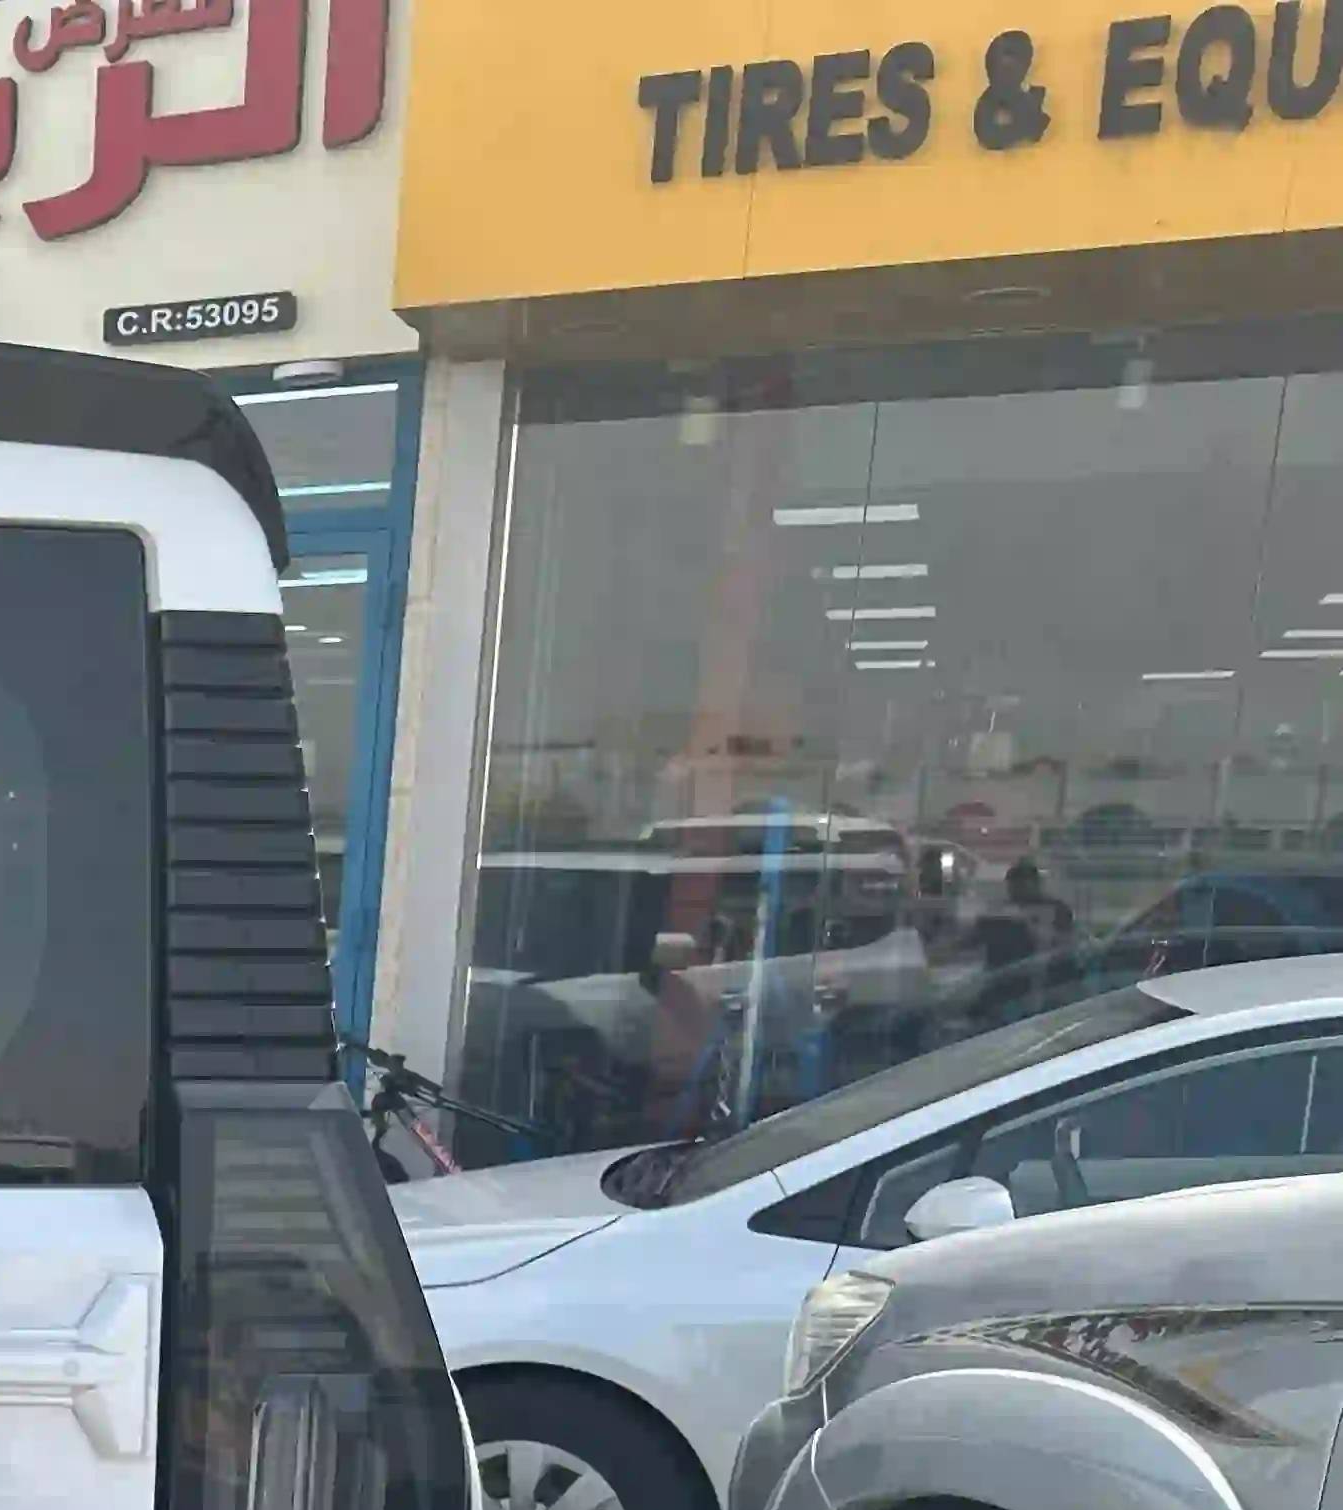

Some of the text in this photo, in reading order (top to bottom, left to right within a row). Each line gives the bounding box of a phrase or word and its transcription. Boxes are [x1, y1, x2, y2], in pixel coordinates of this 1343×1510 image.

[637, 0, 1343, 184] TIRES & EQU
[117, 297, 279, 338] C.R:53095
